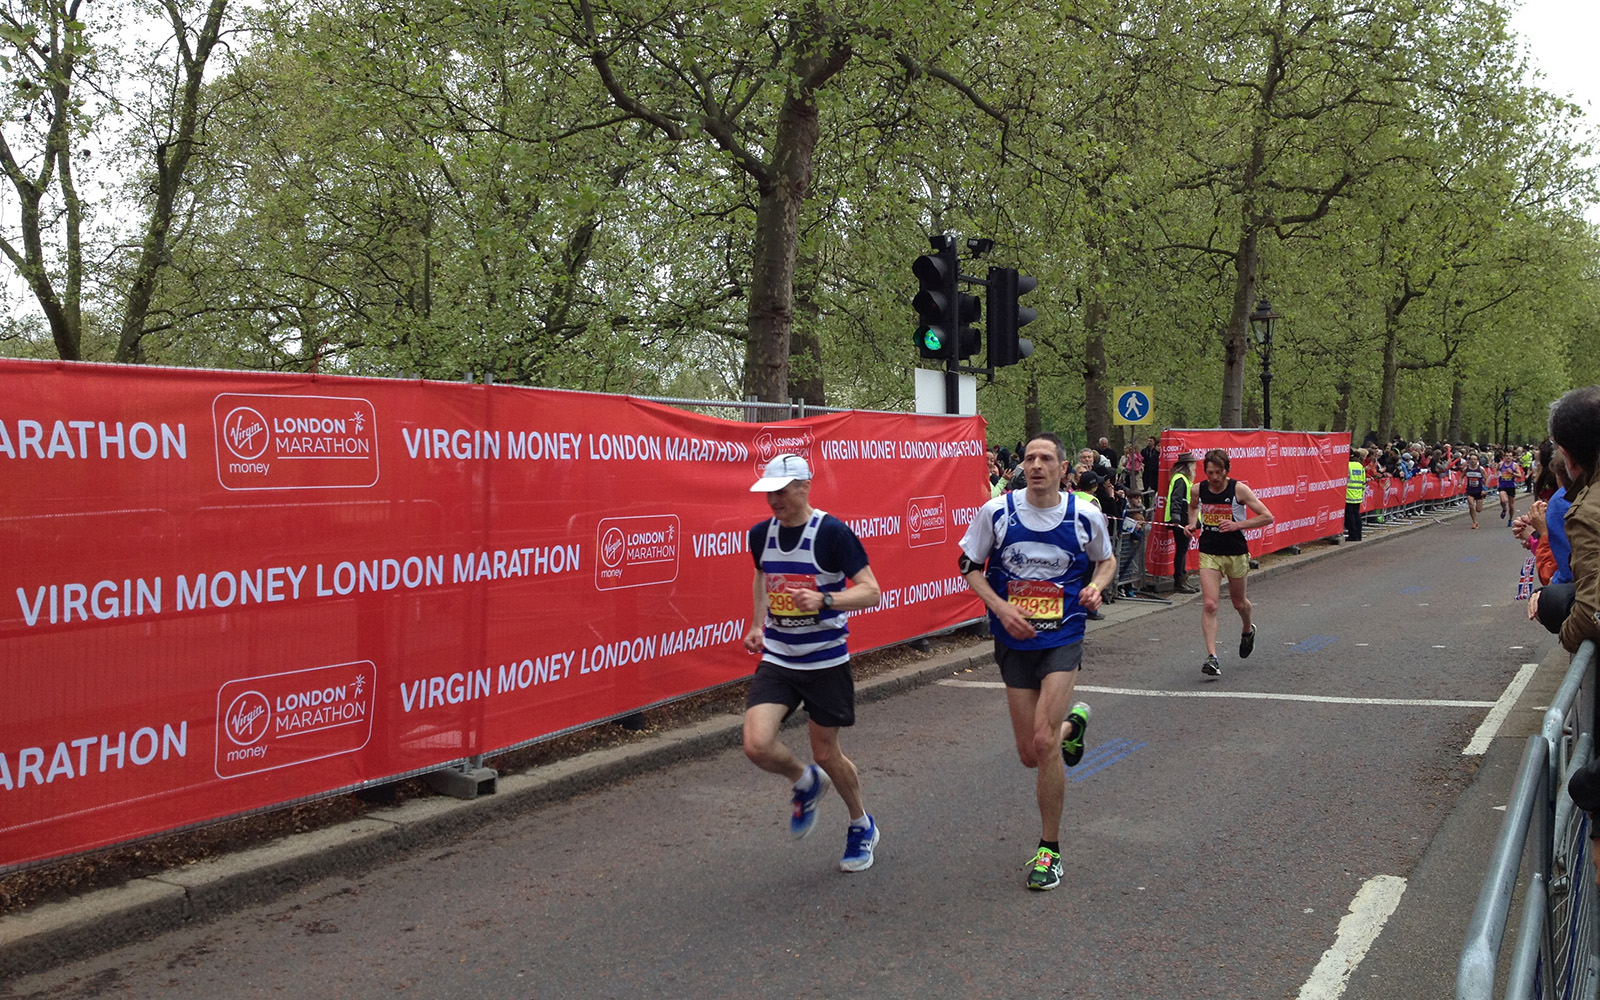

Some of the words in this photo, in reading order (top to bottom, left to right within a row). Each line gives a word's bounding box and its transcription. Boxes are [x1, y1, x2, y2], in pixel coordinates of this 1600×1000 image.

[230, 415, 263, 450] Virgin
[274, 417, 346, 435] LONDON
[0, 419, 187, 460] ARATHON
[276, 437, 370, 455] MARATHON
[402, 427, 500, 460] VIRGIN
[508, 431, 583, 460] MONEY
[589, 433, 660, 460] LONDON
[666, 437, 748, 462] MARATHON
[774, 437, 804, 447] LONDON
[821, 440, 859, 460] VIRGIN
[861, 440, 896, 459] MONEY
[899, 441, 937, 459] LONDON
[939, 440, 983, 458] MARATHON
[229, 462, 270, 476] money
[921, 507, 939, 518] LONDON
[627, 531, 665, 546] LONDON
[692, 530, 742, 558] VIRGIN
[626, 545, 676, 560] MARATHON
[601, 568, 623, 580] money
[16, 576, 161, 626] VIRGIN
[176, 565, 307, 612] MONEY
[316, 554, 443, 597] LONDON
[453, 544, 580, 584] MARATHON
[1032, 586, 1060, 594] money
[769, 595, 796, 611] 298
[865, 588, 901, 615] ONEY
[904, 580, 942, 605] LONDON
[400, 667, 491, 712] VIRGIN
[498, 650, 575, 695] MONEY
[580, 635, 656, 674] LONDON
[660, 618, 745, 657] MARATHON
[276, 685, 347, 712] LONDON
[232, 701, 265, 736] Virgin
[275, 700, 366, 732] MARATHON
[227, 743, 268, 762] money
